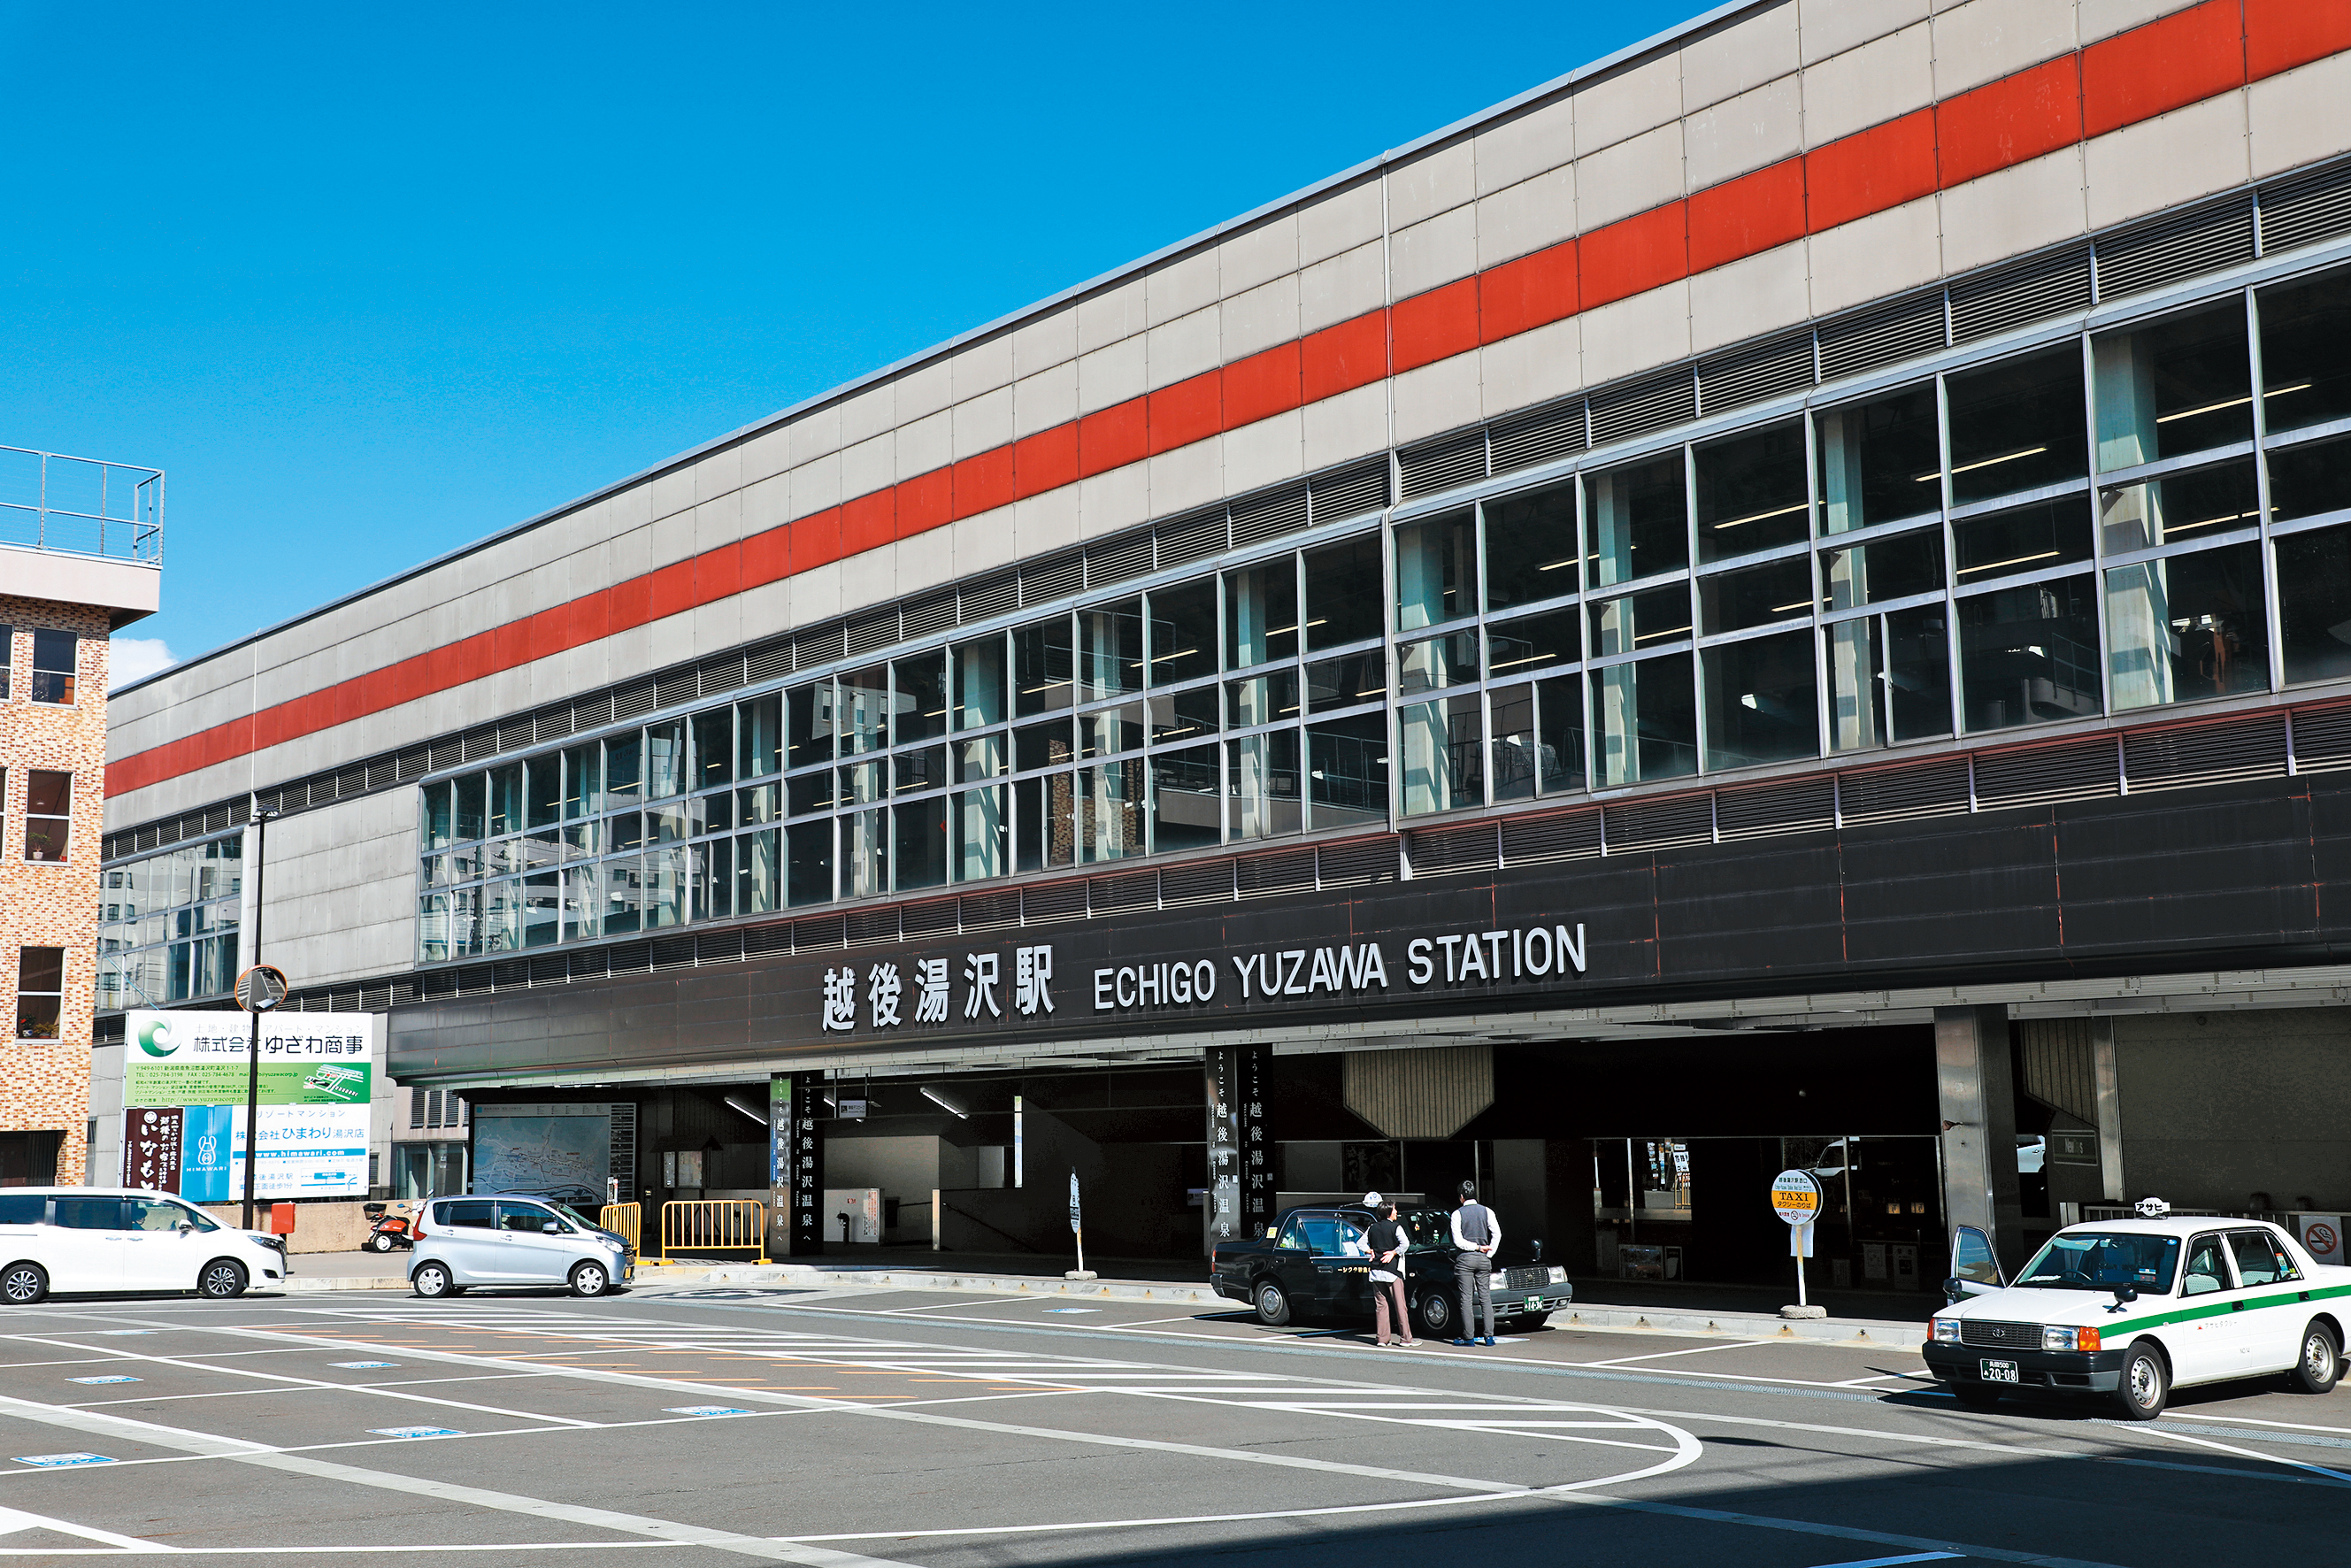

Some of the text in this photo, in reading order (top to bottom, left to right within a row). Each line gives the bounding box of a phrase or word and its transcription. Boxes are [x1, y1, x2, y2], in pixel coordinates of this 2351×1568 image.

[1094, 923, 1587, 1011] ECHIGO YUZAWA STATION
[822, 944, 1056, 1033] 越後湯沢駅
[235, 1127, 365, 1141] 株会社ひまわり湯沢店
[1779, 1192, 1809, 1201] TAXI
[1989, 1368, 2017, 1380] 20-08
